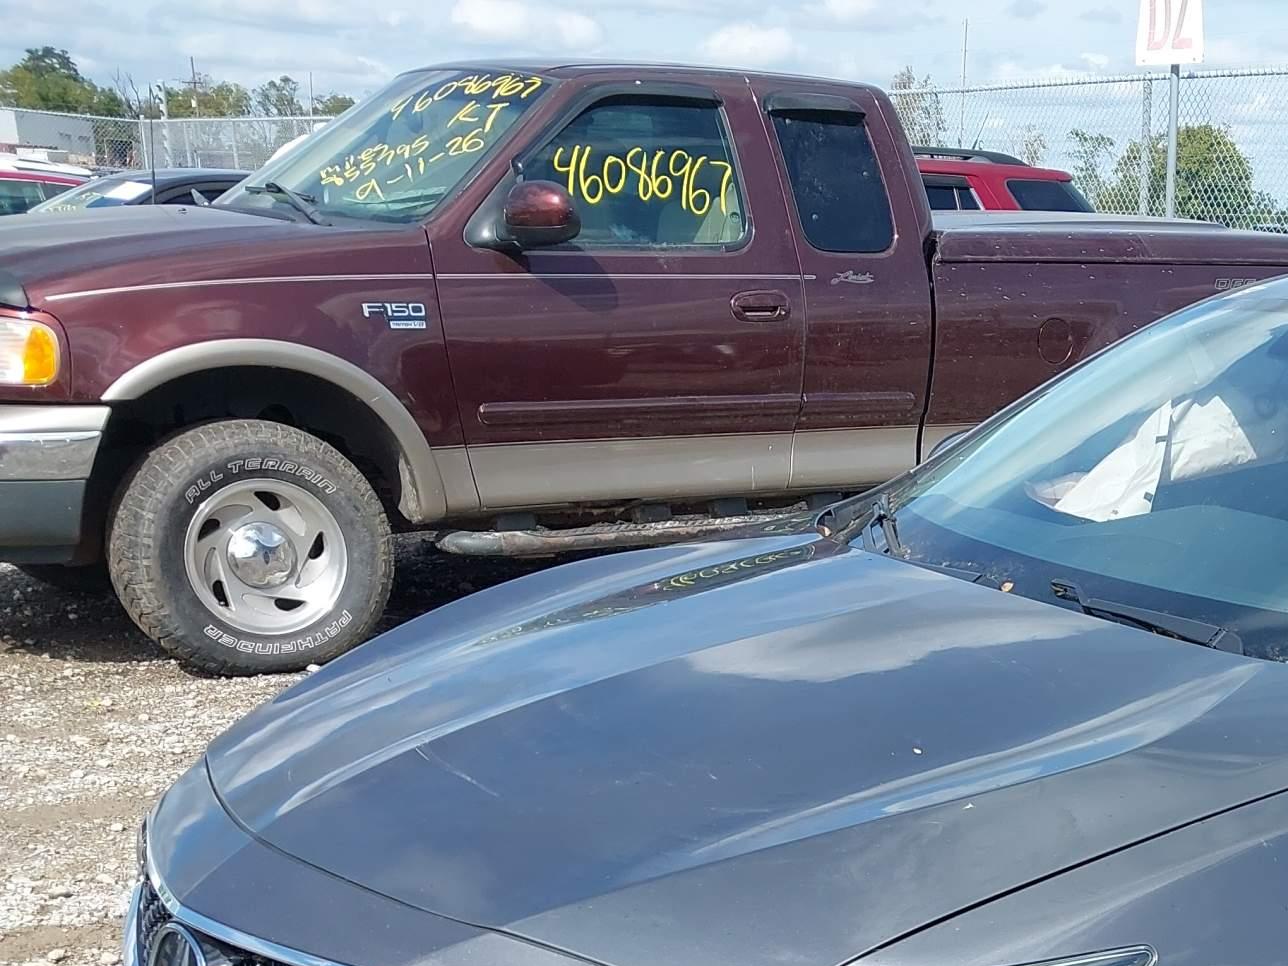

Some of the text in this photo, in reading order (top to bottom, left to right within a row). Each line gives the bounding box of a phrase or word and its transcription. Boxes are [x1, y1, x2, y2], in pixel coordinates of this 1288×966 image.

[390, 71, 543, 120] 46086967
[446, 100, 510, 133] KT
[553, 144, 733, 216] 46086967
[184, 457, 337, 505] ALL TERRAIN
[203, 609, 353, 656] PATHFINDER
